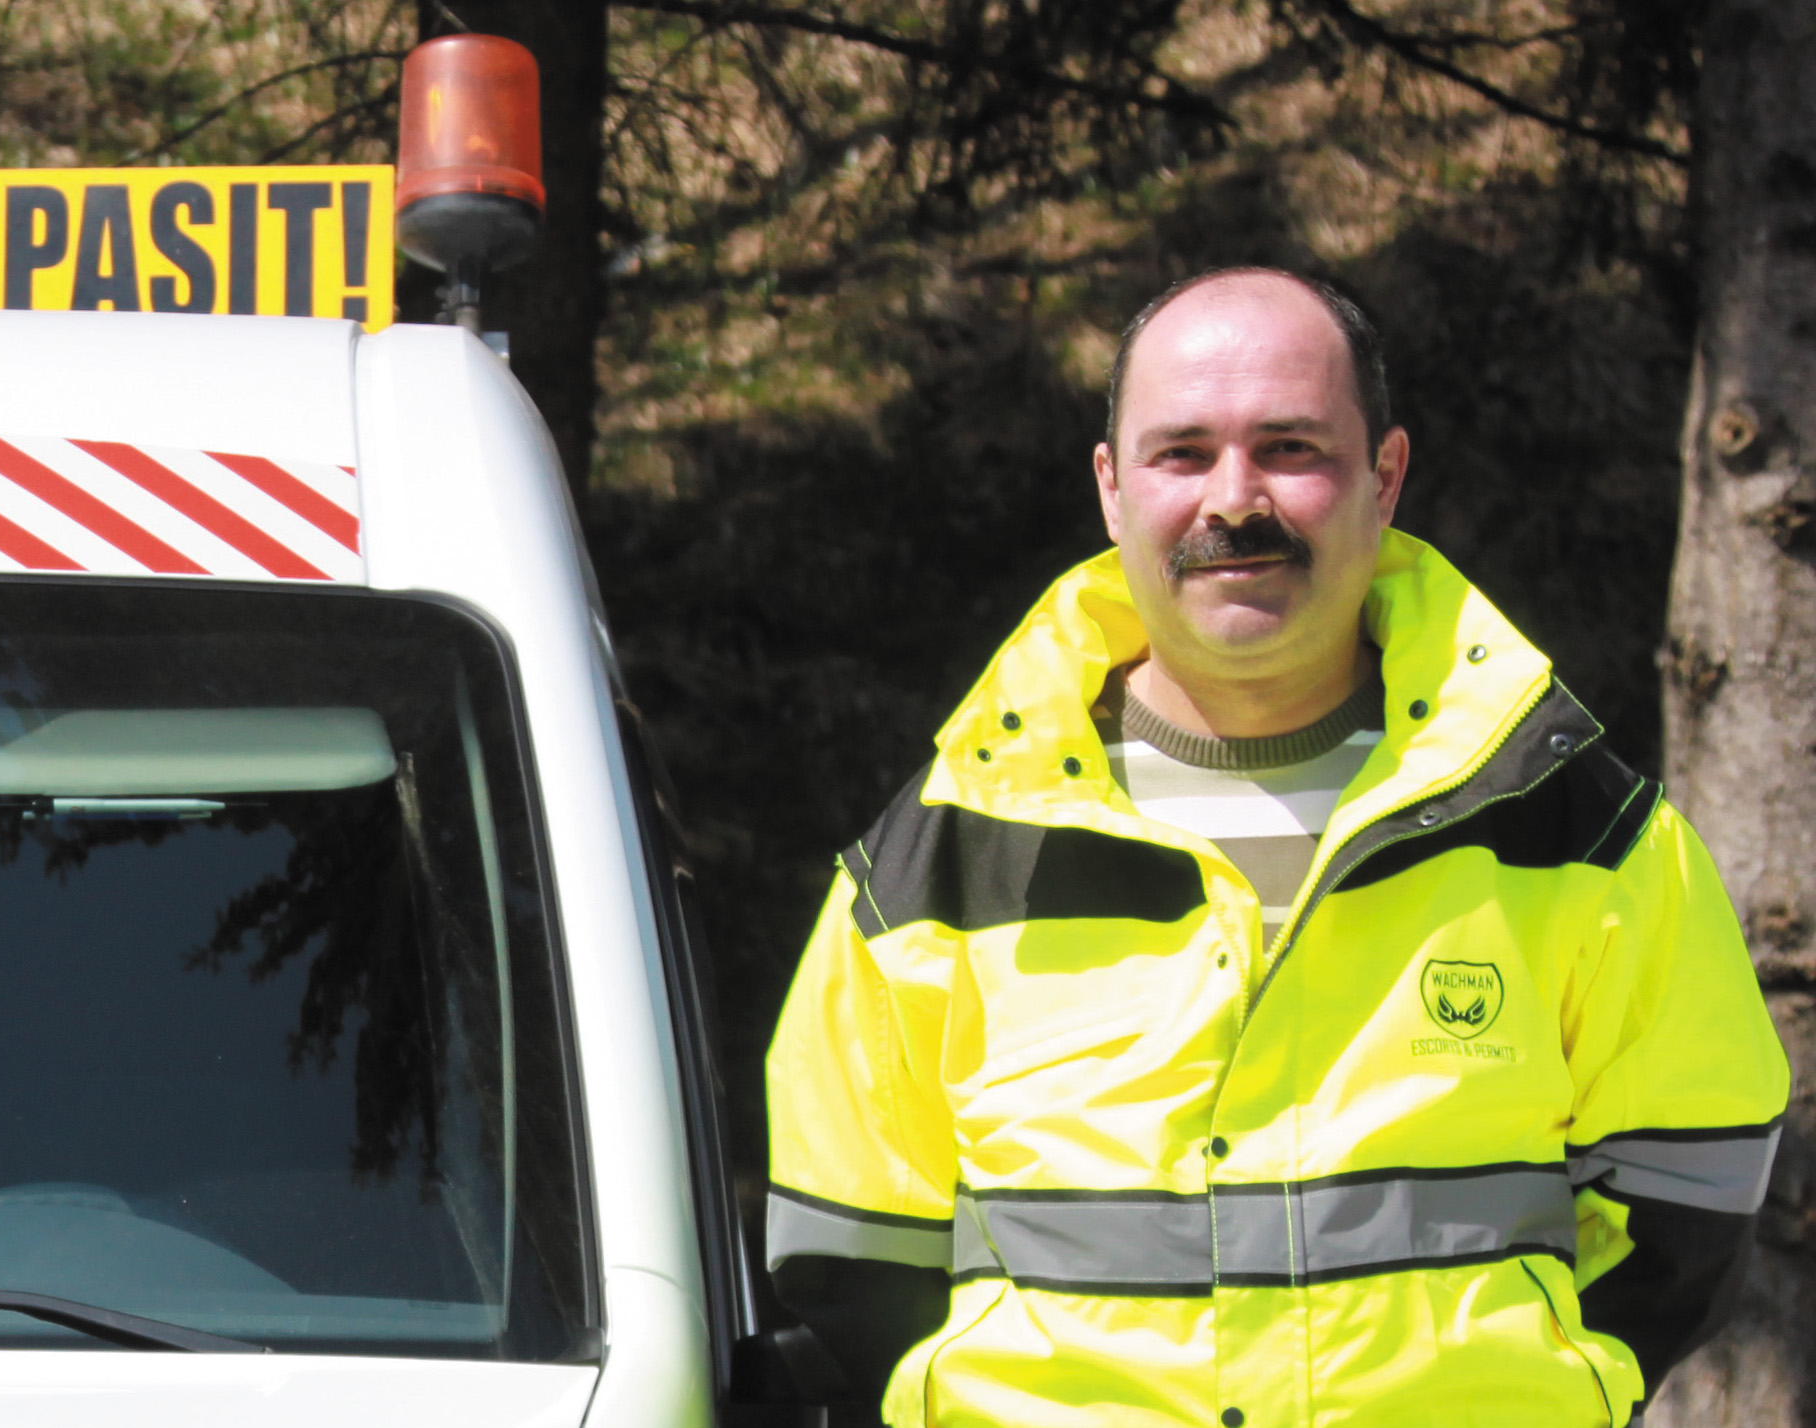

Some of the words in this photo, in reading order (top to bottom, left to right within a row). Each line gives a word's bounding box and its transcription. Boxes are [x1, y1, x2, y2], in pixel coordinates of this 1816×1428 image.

[1432, 972, 1494, 991] WACHMAN
[1411, 1038, 1461, 1056] ESCORTS
[1474, 1043, 1516, 1062] PERMITS
